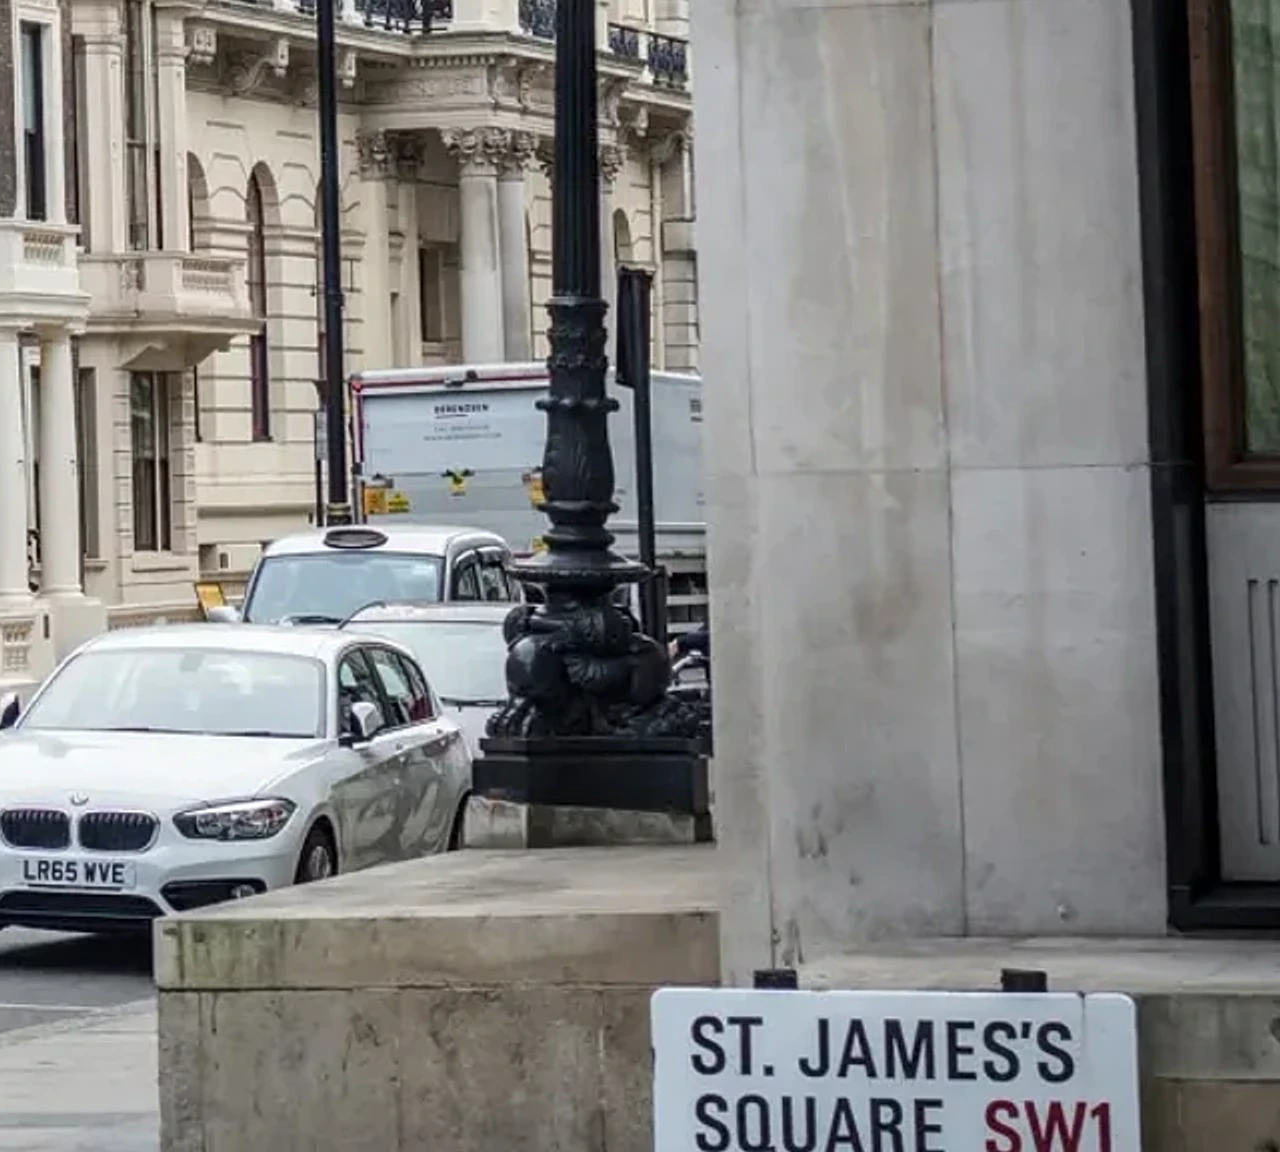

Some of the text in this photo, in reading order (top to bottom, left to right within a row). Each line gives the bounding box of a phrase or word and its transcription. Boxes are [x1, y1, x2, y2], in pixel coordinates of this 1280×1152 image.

[23, 859, 126, 884] LR65 WVE
[690, 1015, 1075, 1084] ST. JAMES'S
[694, 1093, 1113, 1152] SQUARE SW1
